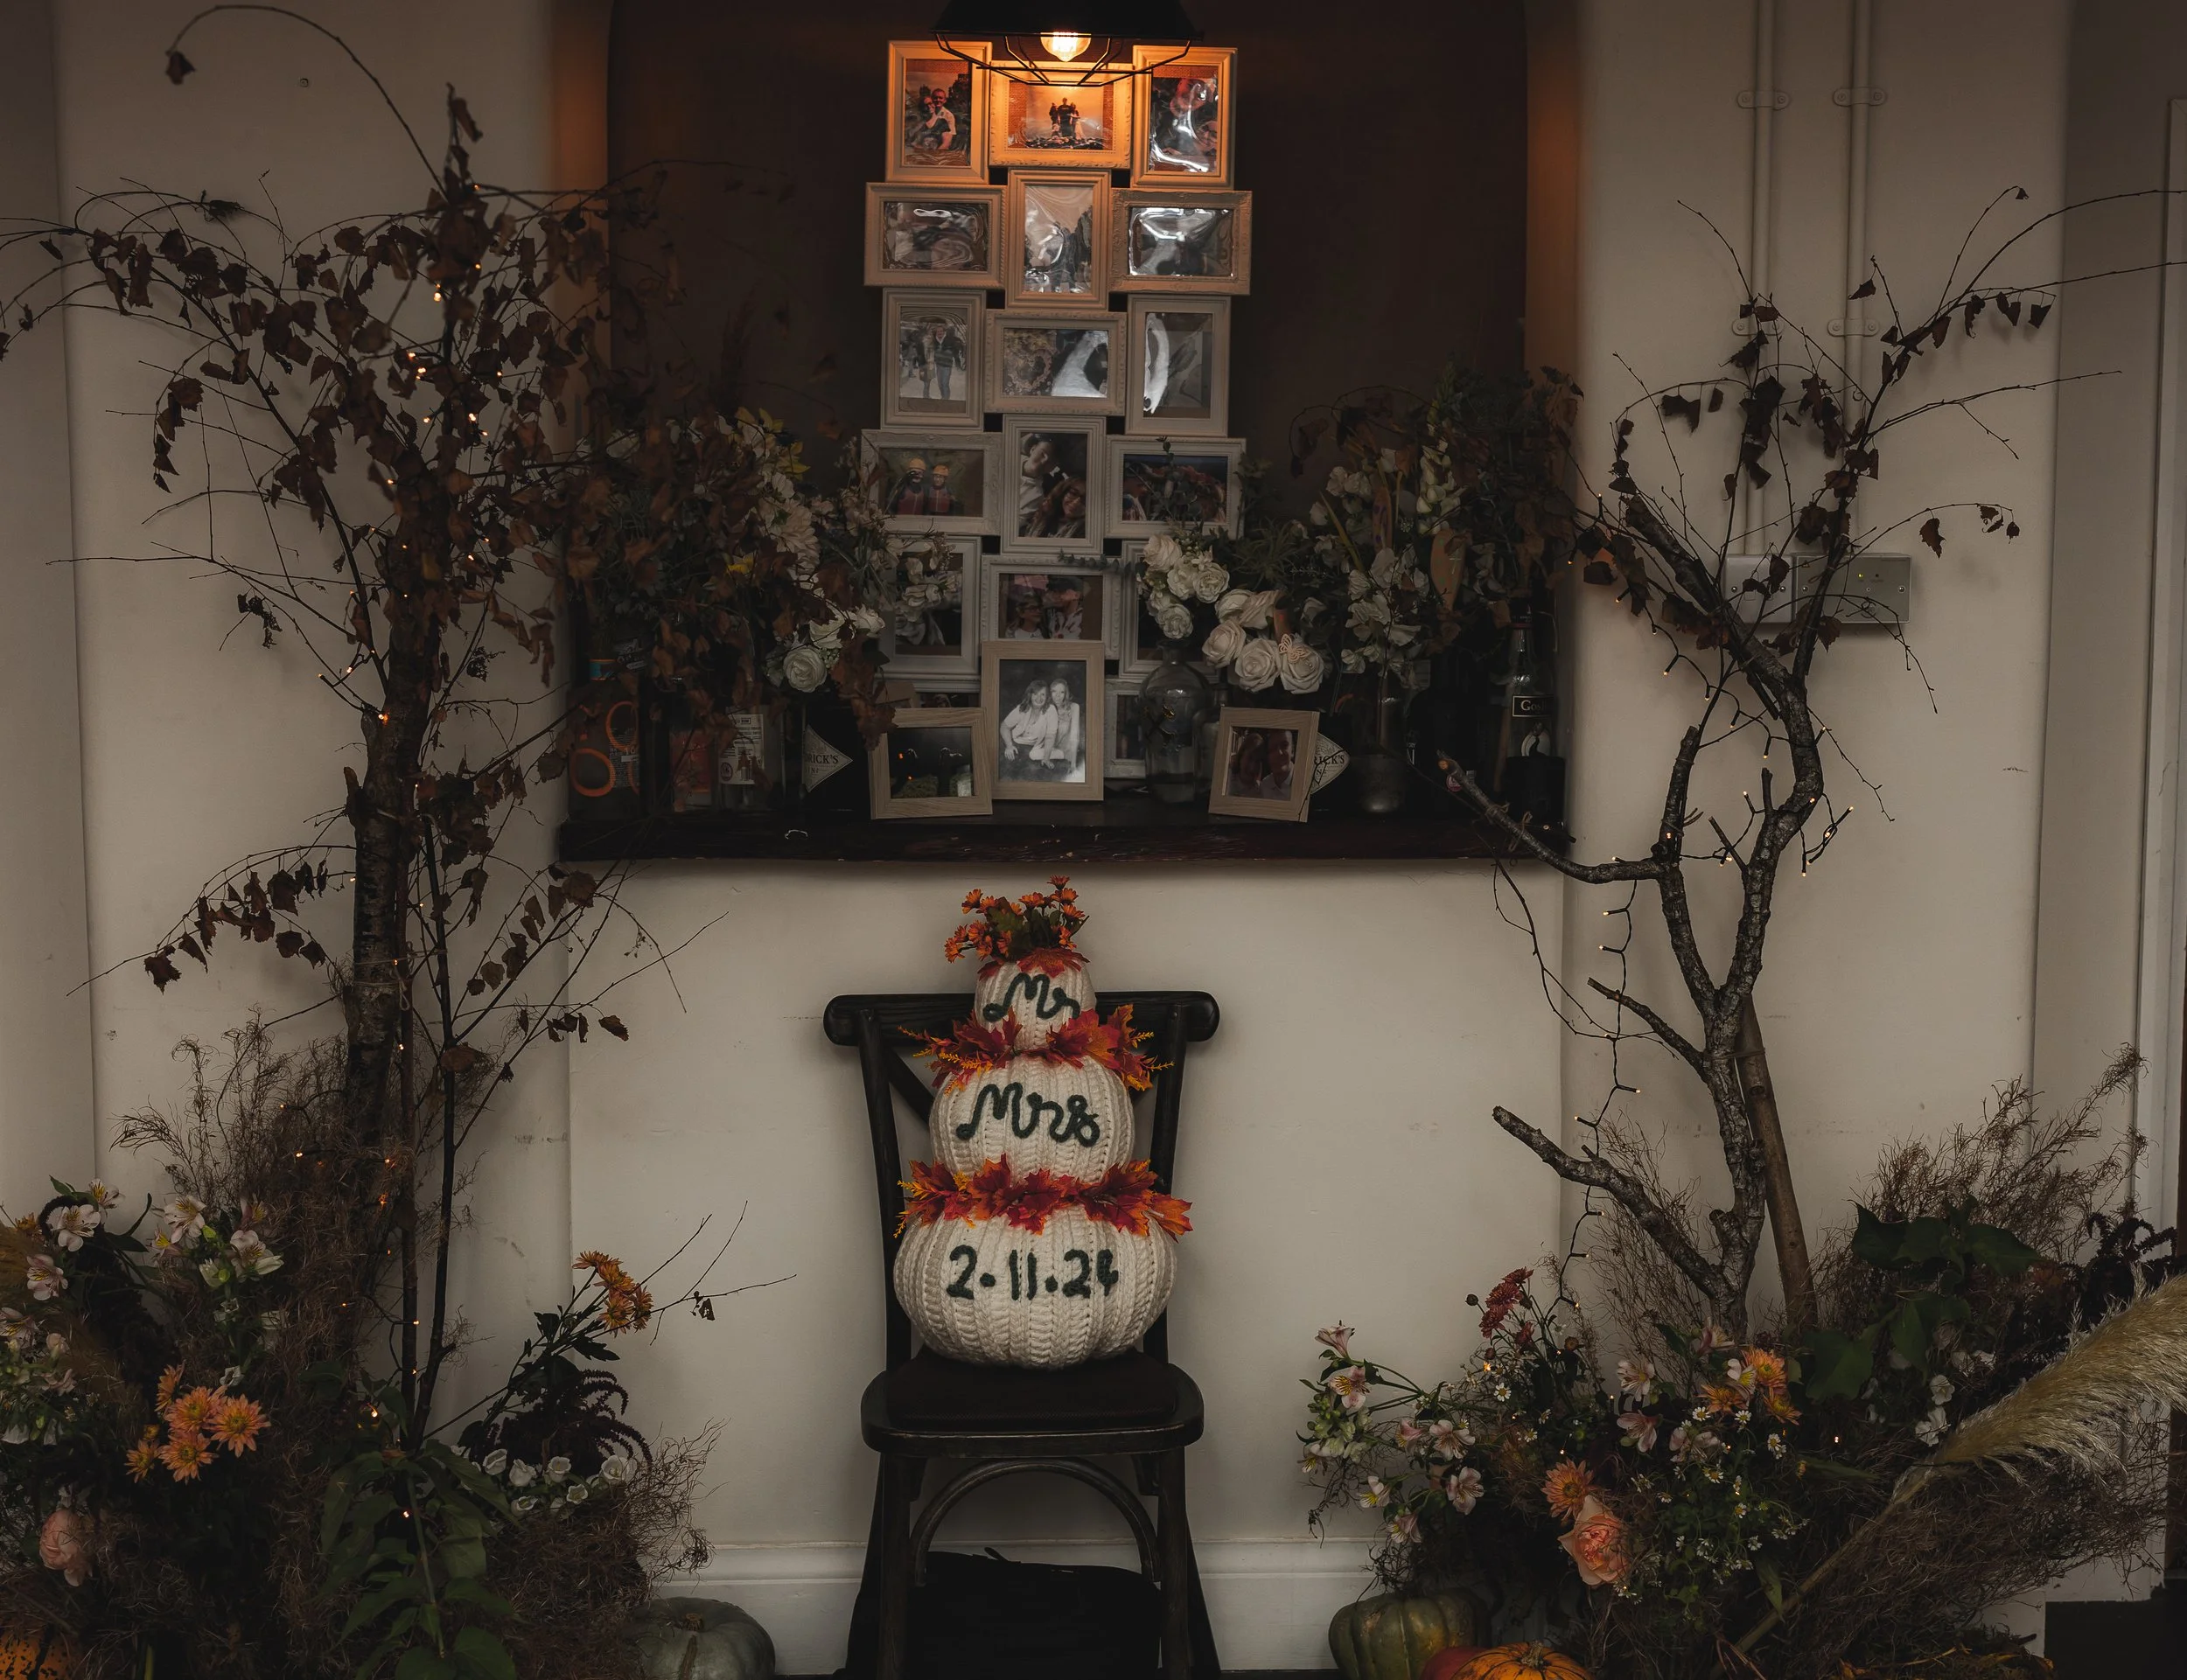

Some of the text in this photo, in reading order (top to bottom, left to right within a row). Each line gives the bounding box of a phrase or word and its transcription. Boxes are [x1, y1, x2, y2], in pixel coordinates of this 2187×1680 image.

[982, 972, 1080, 1022] Mr
[955, 1081, 1100, 1147] Mrs
[947, 1244, 1121, 1300] 2.11.24
